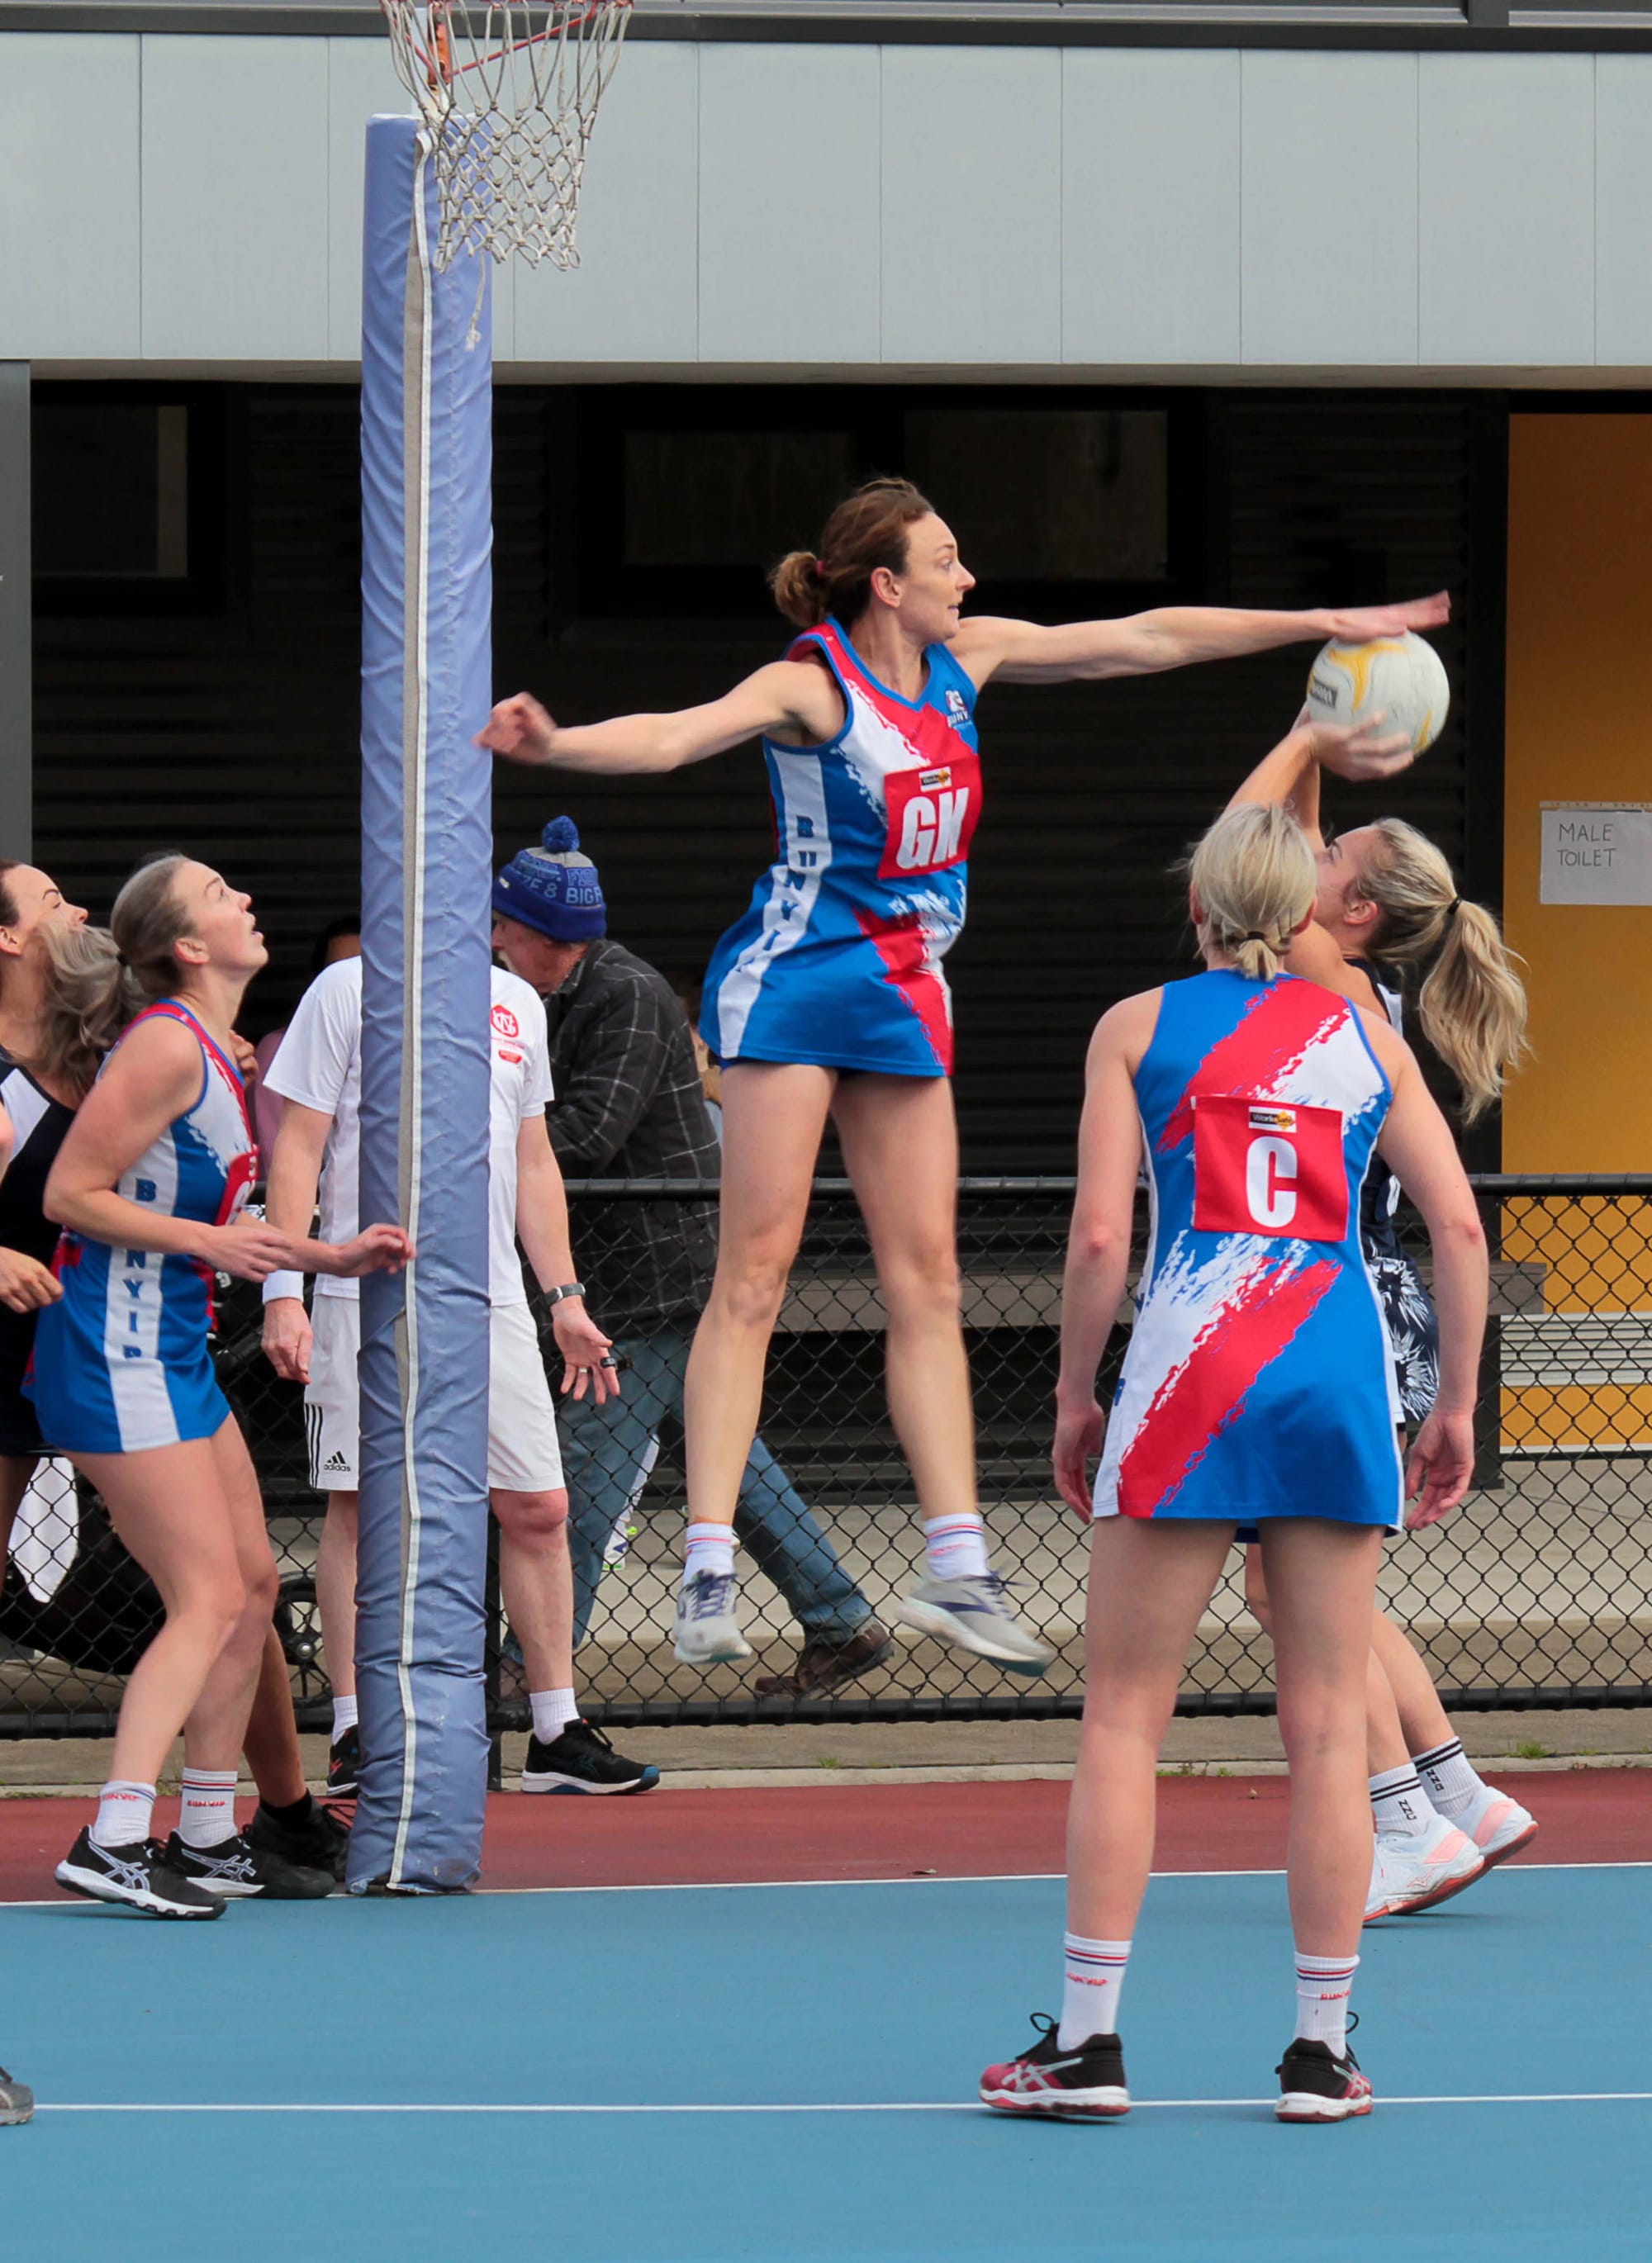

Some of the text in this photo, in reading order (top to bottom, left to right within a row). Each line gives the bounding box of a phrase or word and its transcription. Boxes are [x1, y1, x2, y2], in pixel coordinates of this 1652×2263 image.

[896, 787, 969, 869] GK
[1559, 823, 1613, 842] MALE
[1557, 847, 1617, 866] TOILET
[1246, 1136, 1297, 1228] C
[122, 1178, 157, 1359] BNYIP
[324, 1464, 351, 1472] adidas
